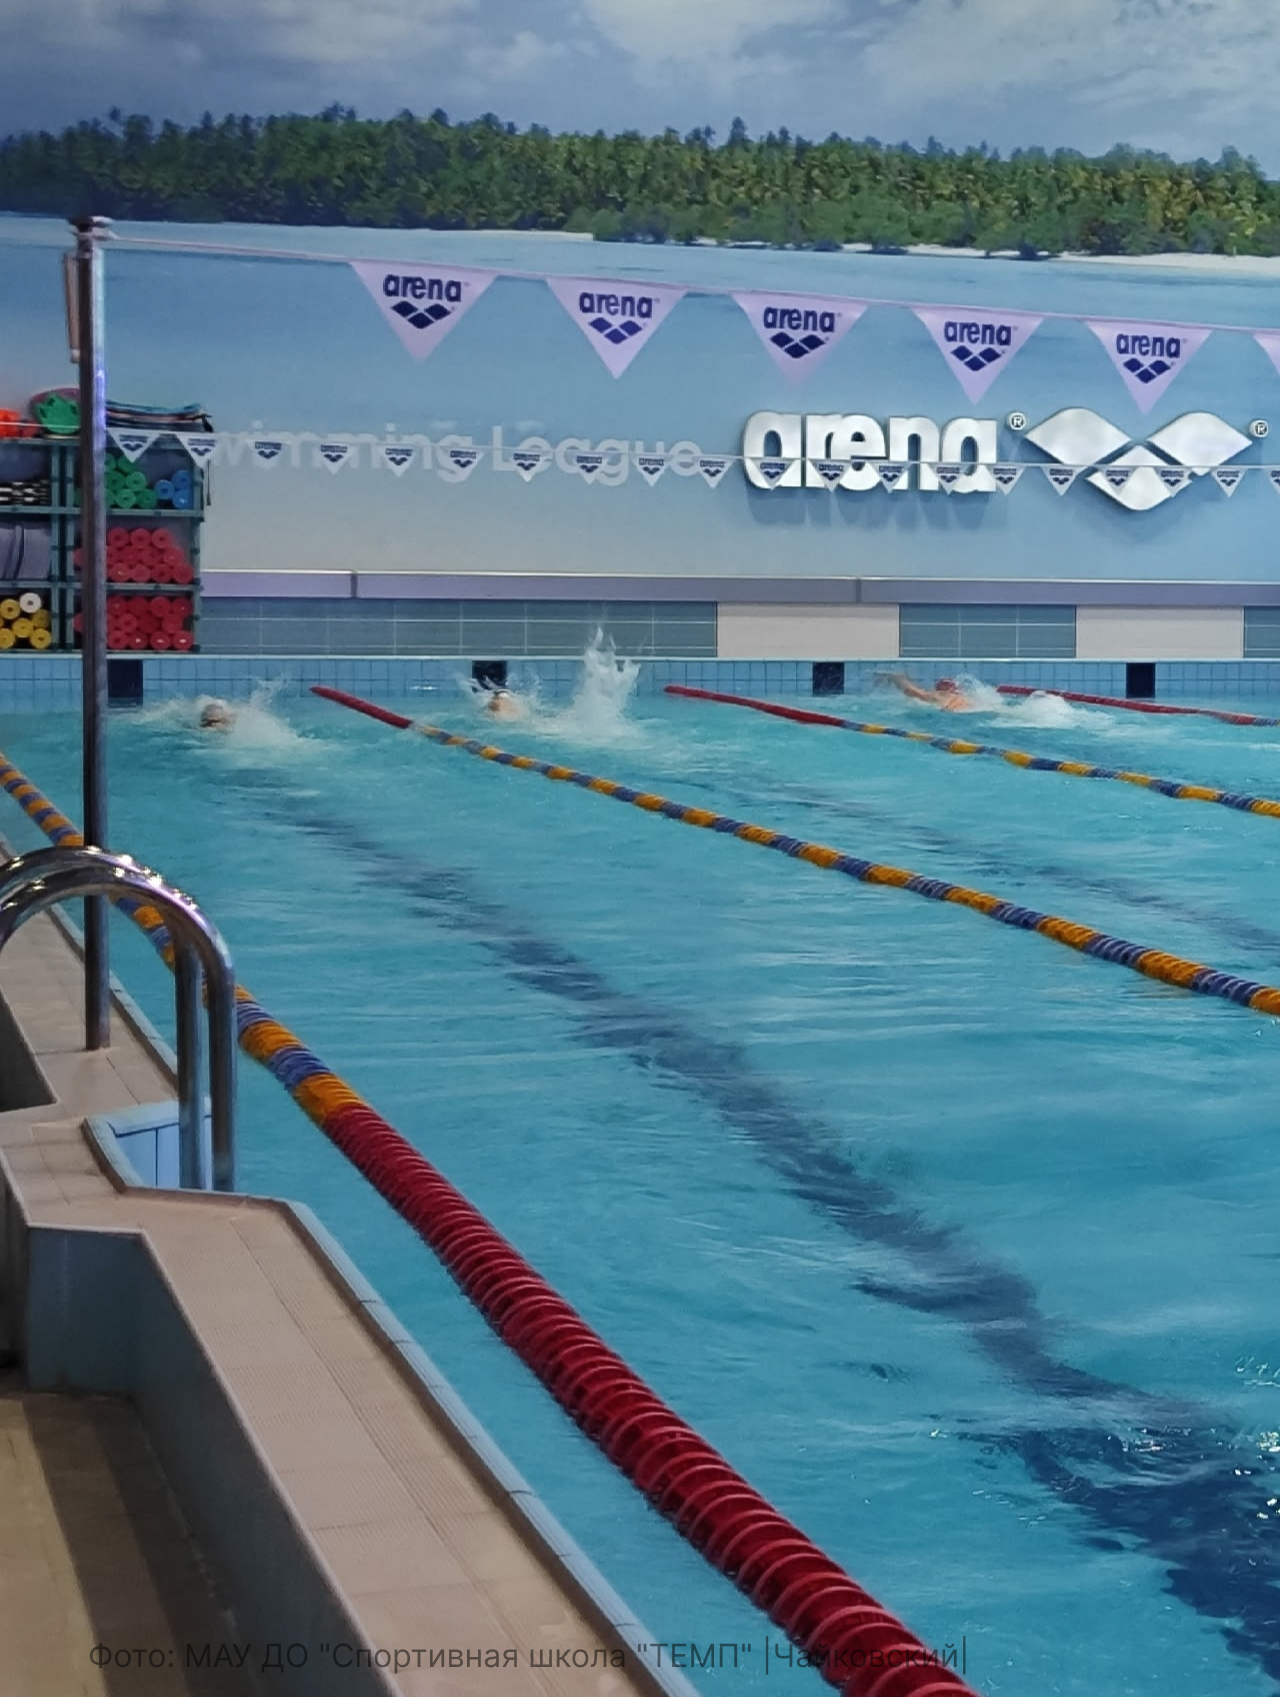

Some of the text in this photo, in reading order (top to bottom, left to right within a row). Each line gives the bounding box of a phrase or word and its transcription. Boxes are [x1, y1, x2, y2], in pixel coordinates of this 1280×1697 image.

[383, 274, 461, 301] arena
[579, 290, 652, 319] arena
[763, 306, 835, 332] arena
[944, 320, 1011, 346] arena
[1116, 333, 1181, 358] arena
[744, 411, 997, 492] arena
